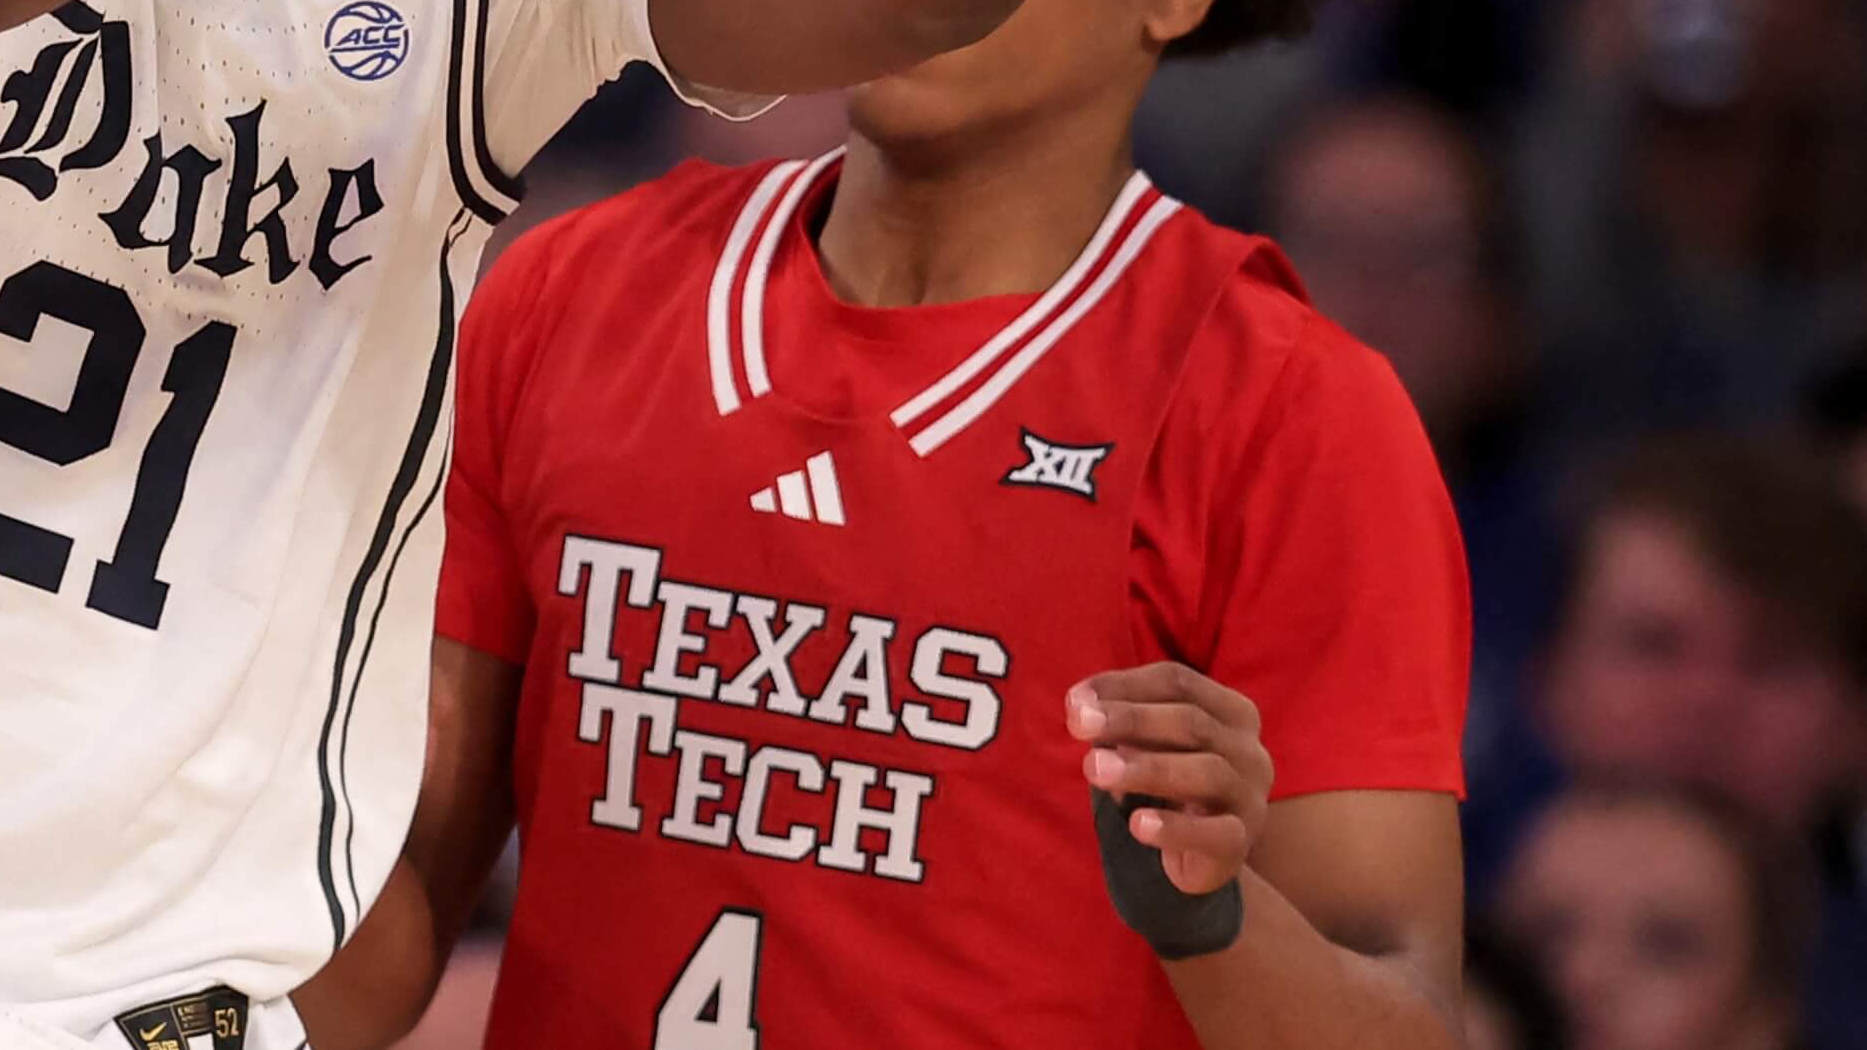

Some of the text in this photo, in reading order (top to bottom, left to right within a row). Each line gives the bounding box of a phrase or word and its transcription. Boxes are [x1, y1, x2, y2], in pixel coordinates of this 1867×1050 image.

[333, 23, 405, 50] ACC
[1000, 427, 1114, 501] XII
[557, 533, 1009, 751] TEXAS
[578, 681, 934, 883] TECH
[213, 1006, 240, 1039] 52
[652, 905, 764, 1050] 4
